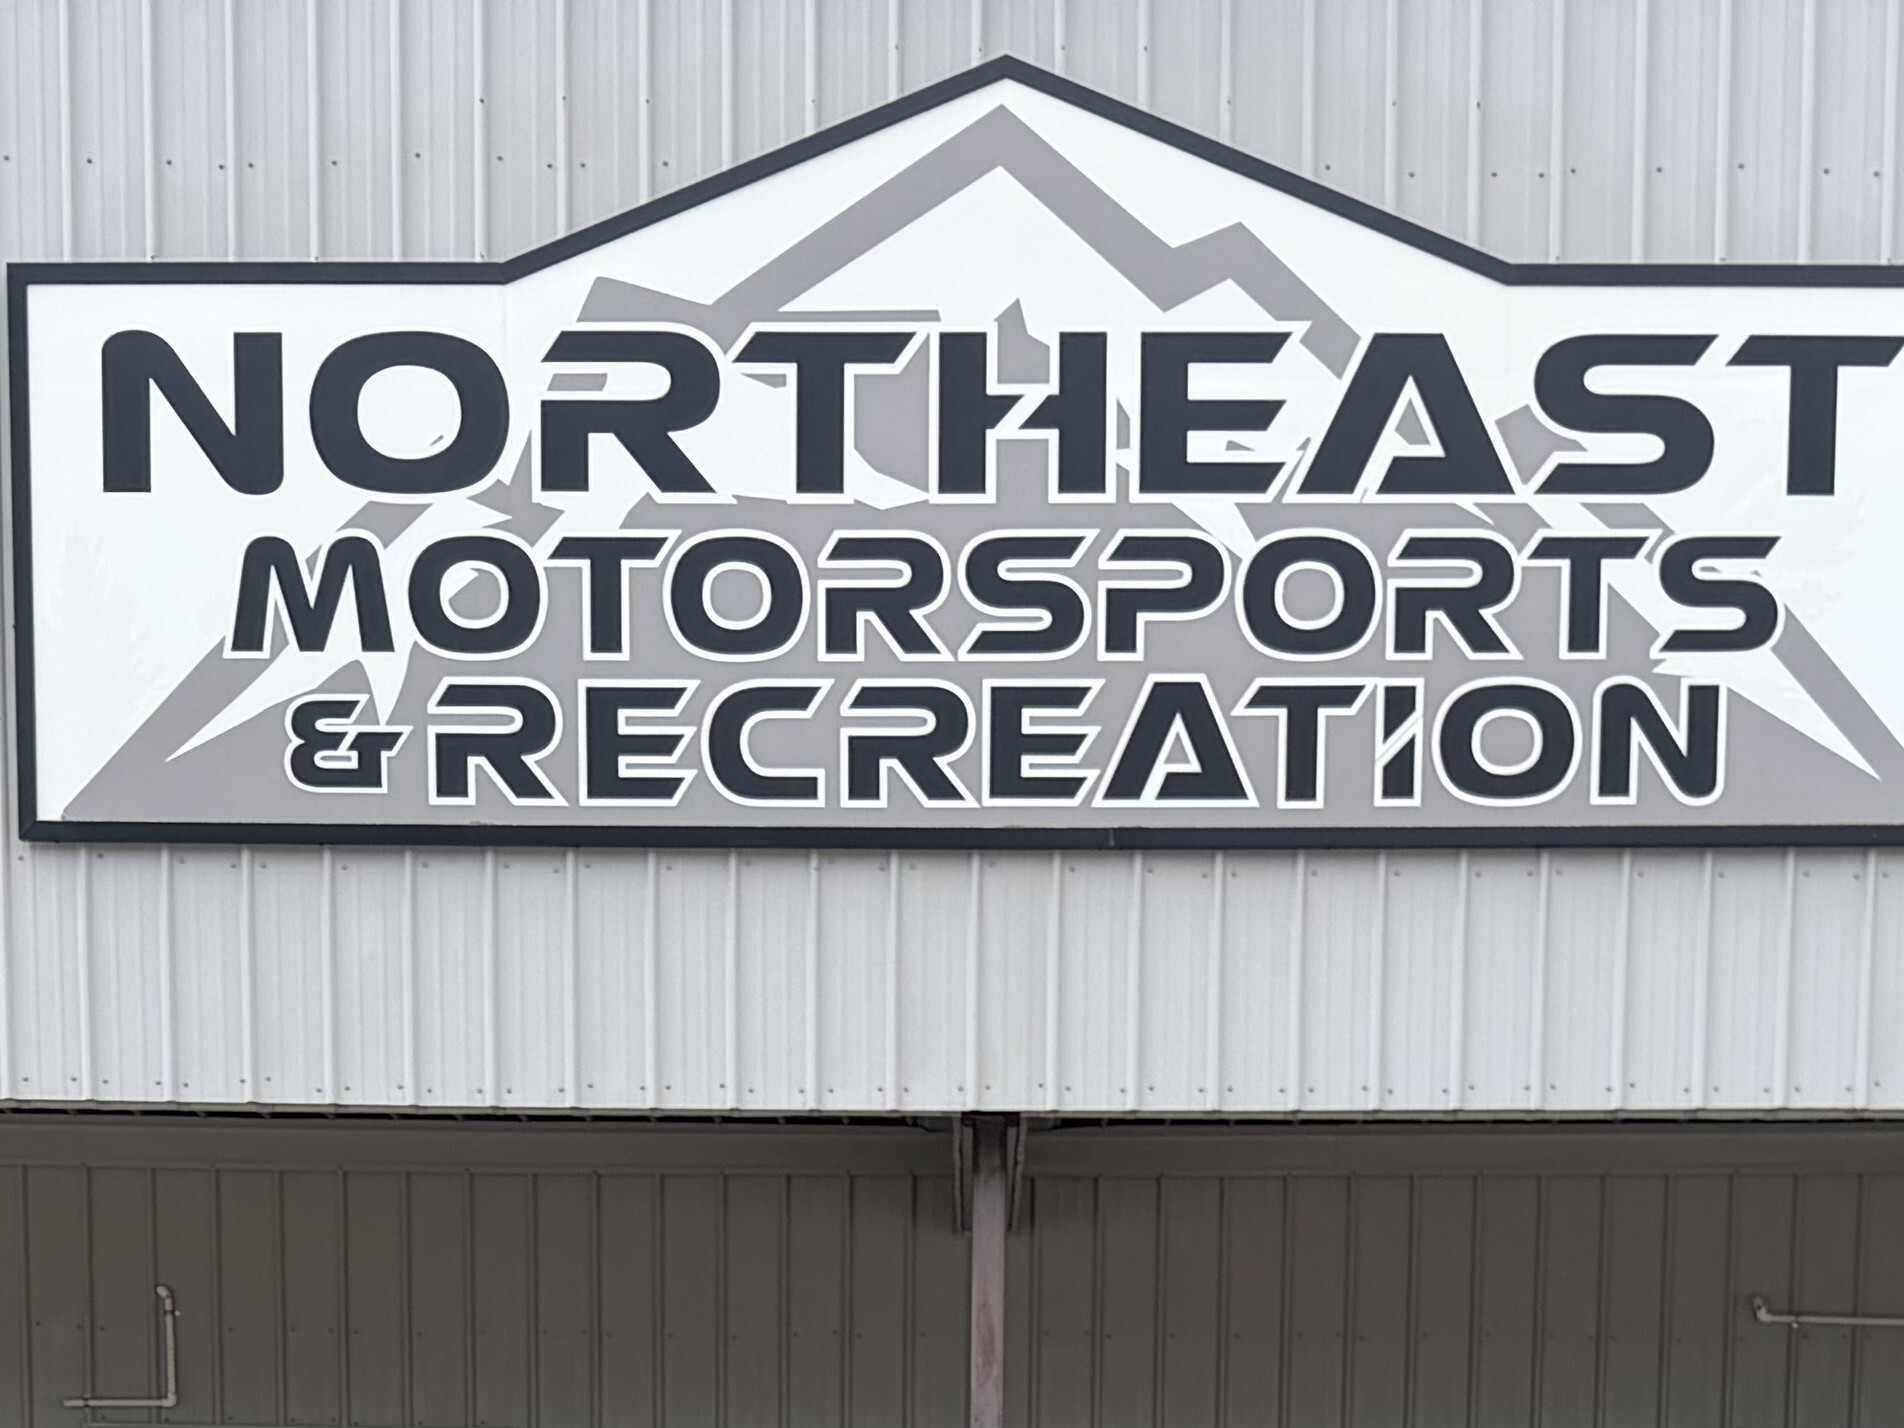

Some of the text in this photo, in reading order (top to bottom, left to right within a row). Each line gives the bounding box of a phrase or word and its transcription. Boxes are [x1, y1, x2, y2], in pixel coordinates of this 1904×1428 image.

[227, 535, 1780, 655] MOTORSPORTS
[288, 680, 1721, 806] & RECREATION
